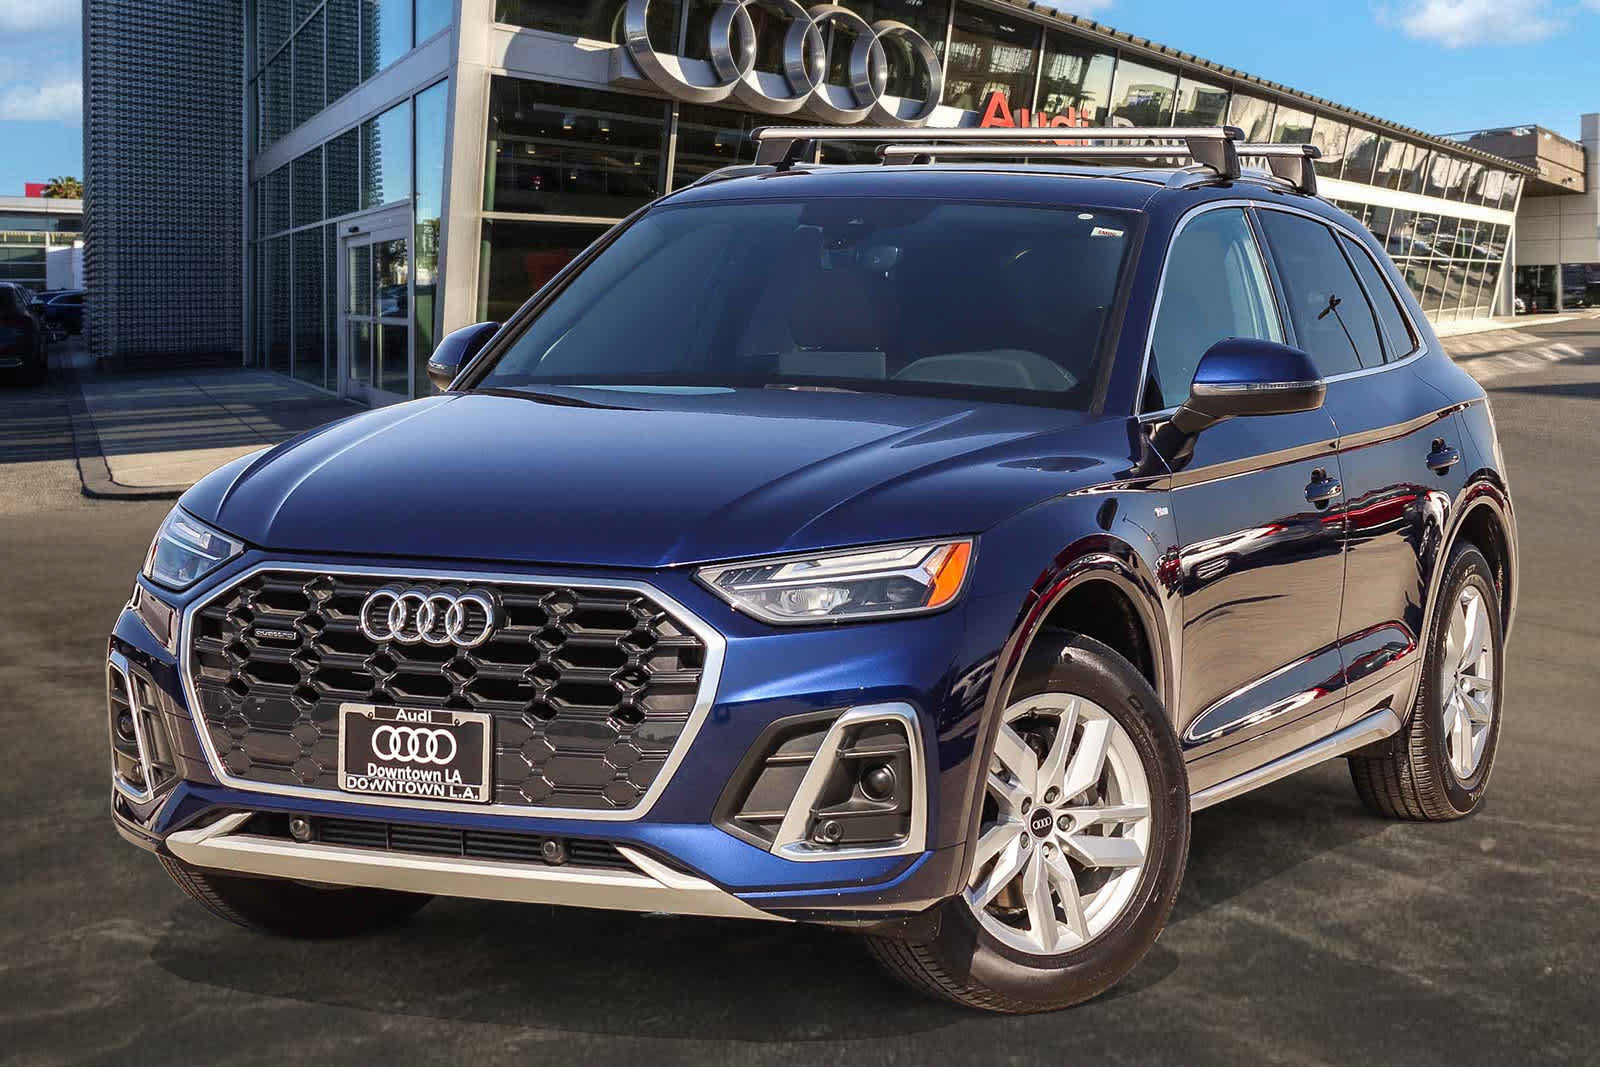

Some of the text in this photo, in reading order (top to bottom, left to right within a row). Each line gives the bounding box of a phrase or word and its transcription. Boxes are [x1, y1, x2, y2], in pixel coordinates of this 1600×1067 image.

[980, 90, 1089, 146] Audi
[396, 708, 432, 723] Audi
[367, 763, 462, 784] Downtown LA
[347, 777, 479, 800] DOWNTOWN L.A.
